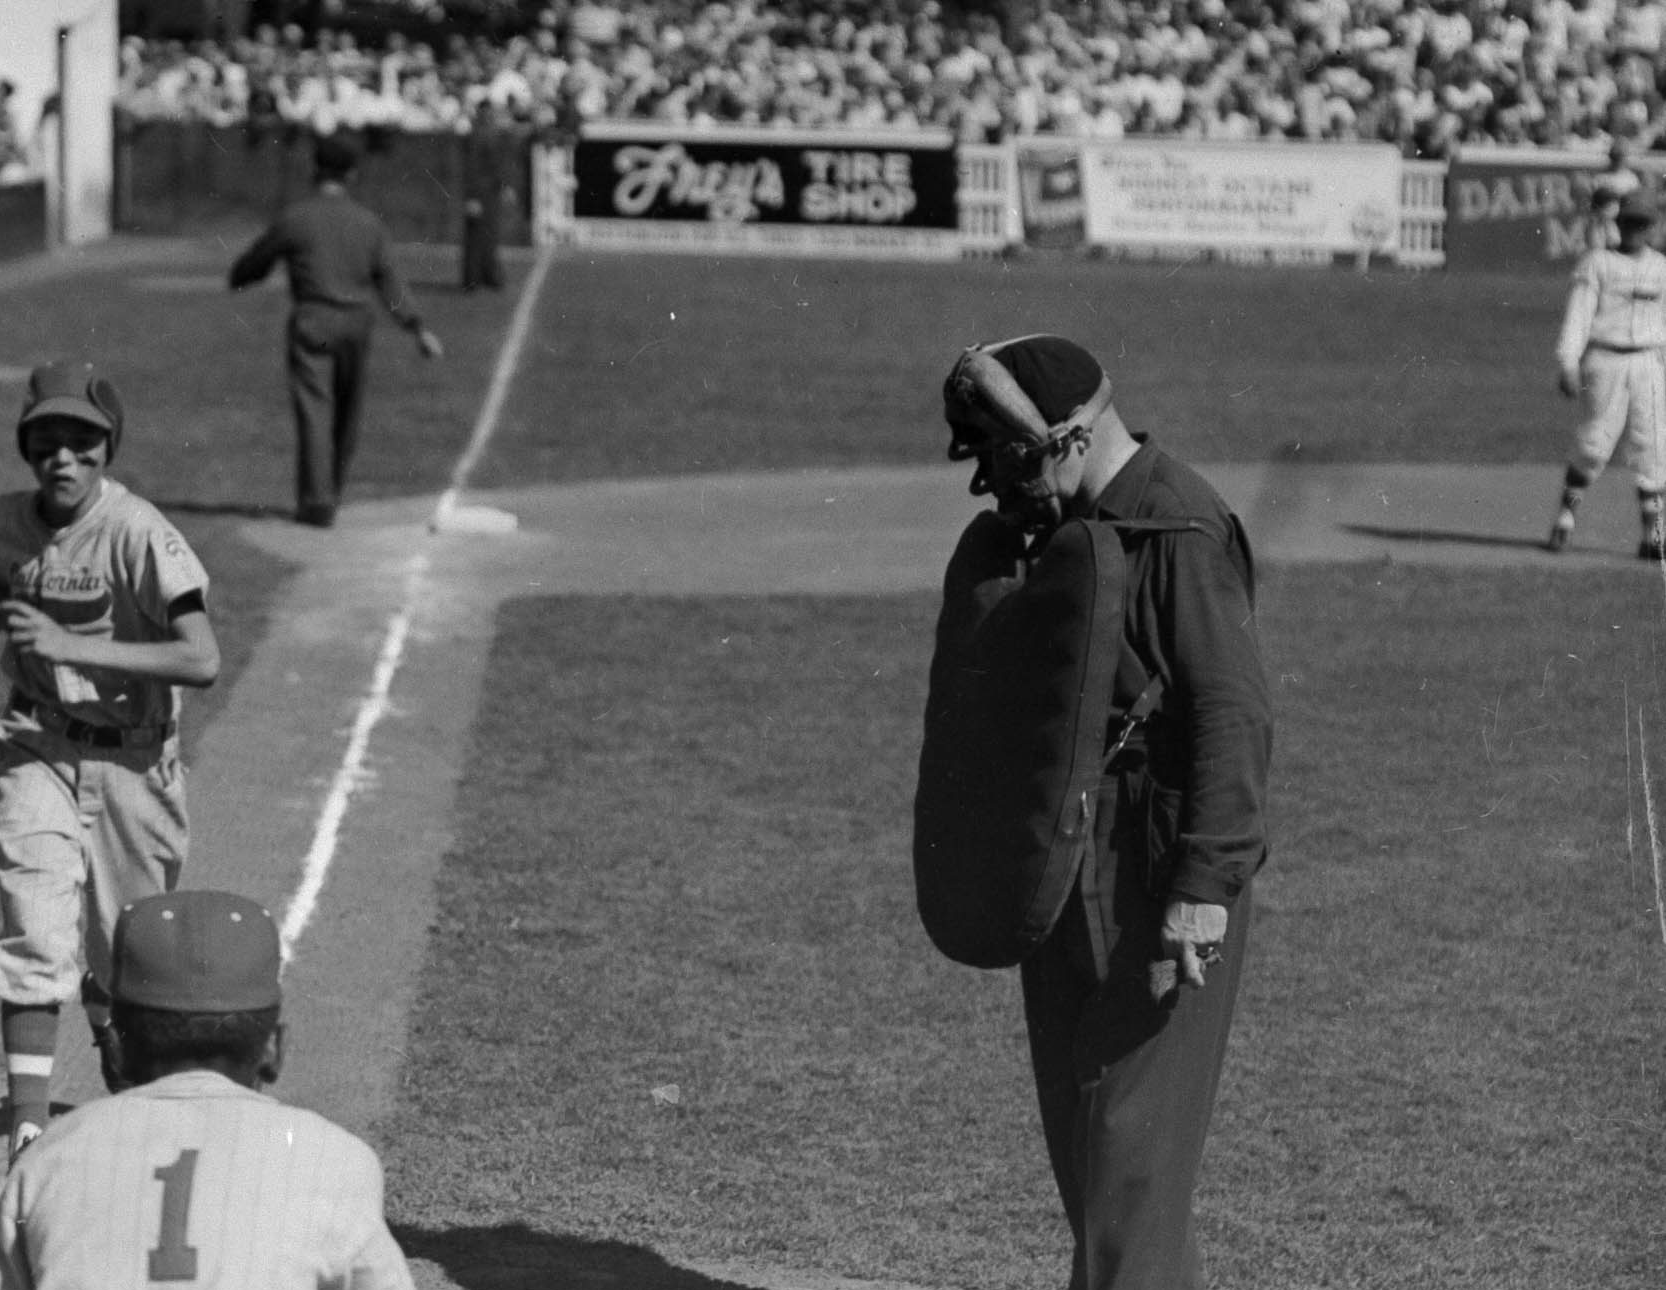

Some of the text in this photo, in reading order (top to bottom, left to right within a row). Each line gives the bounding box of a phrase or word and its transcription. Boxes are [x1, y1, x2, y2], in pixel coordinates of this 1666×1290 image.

[800, 150, 912, 186] TIRE
[798, 182, 917, 224] SHOP
[147, 1148, 200, 1282] 1
